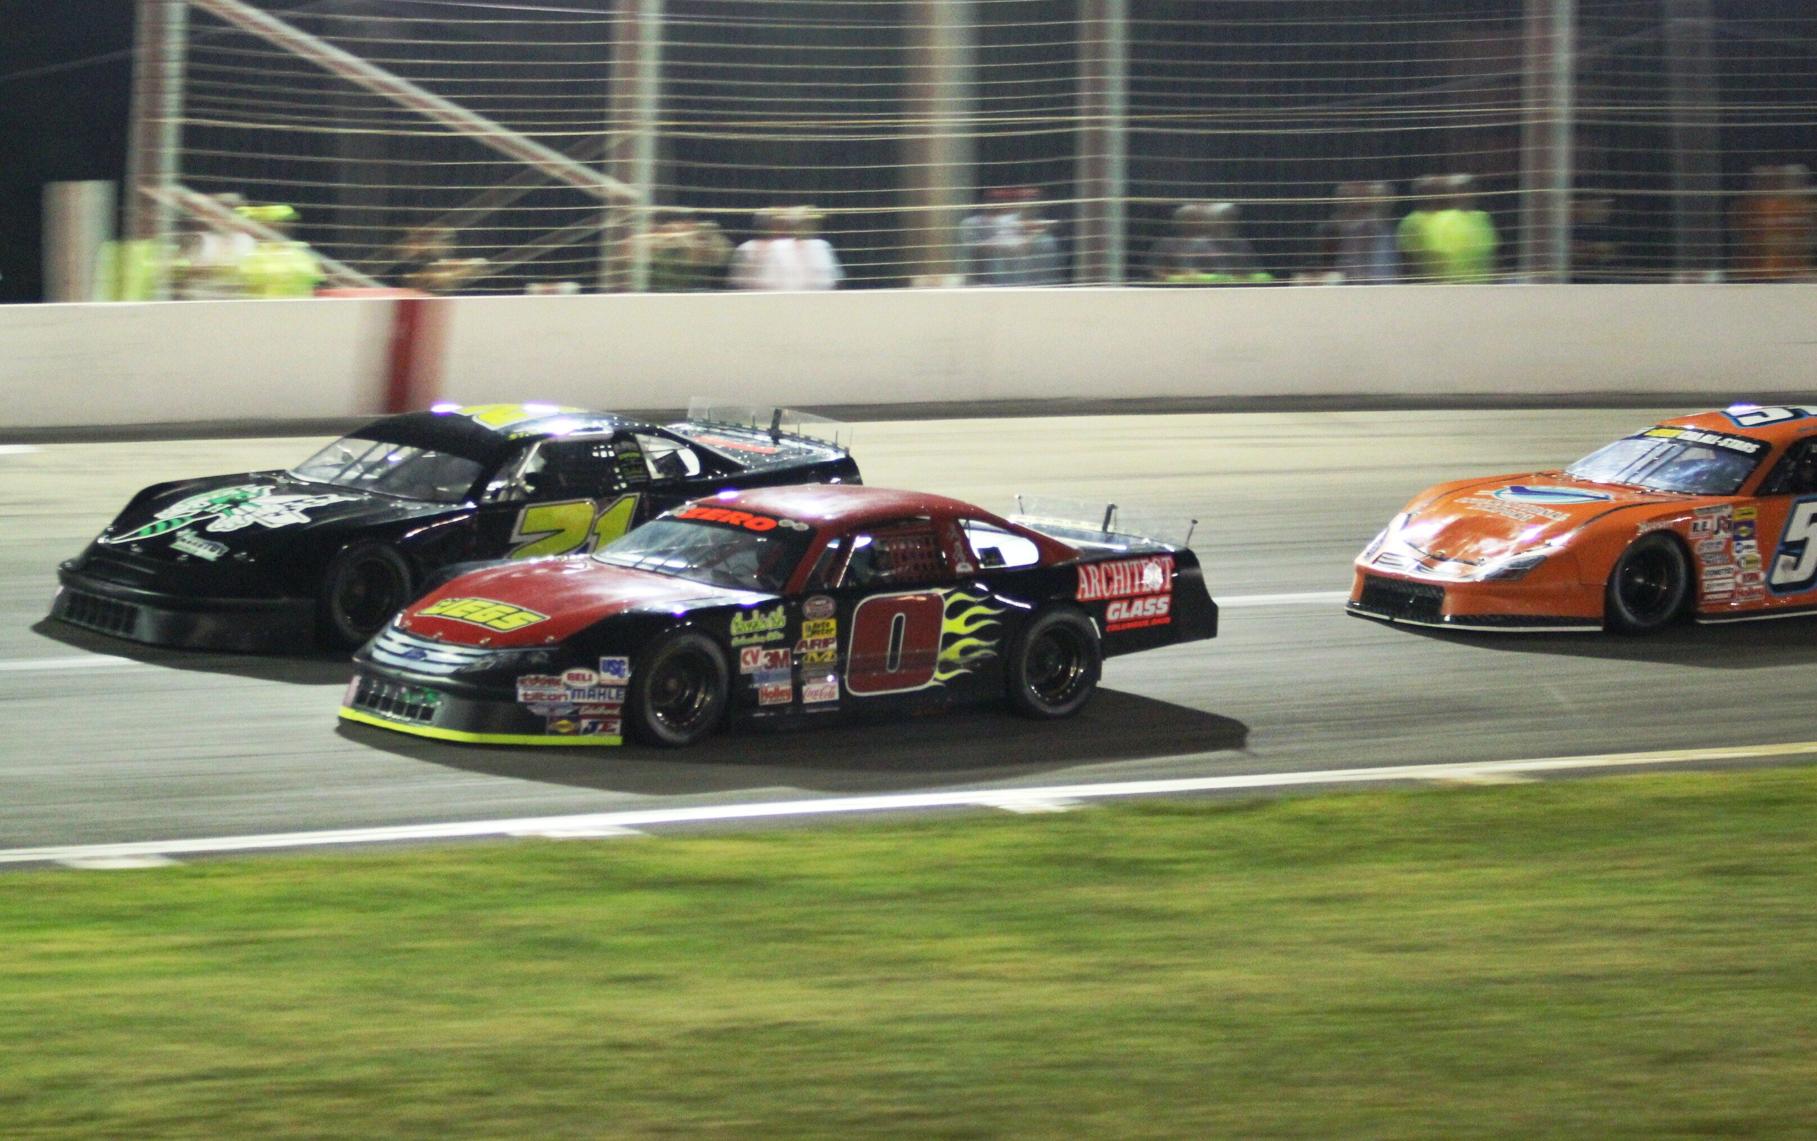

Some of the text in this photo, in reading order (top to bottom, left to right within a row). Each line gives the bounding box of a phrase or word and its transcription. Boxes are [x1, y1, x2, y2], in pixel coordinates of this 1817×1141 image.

[508, 492, 640, 560] 21
[677, 507, 778, 532] ZERO
[1076, 556, 1174, 601] ARCHITT
[415, 598, 550, 632] JEGS
[1105, 596, 1171, 622] GLASS
[796, 639, 835, 651] ARP
[763, 650, 790, 669] 3M
[570, 687, 624, 701] MAHLE
[760, 686, 791, 700] Holley
